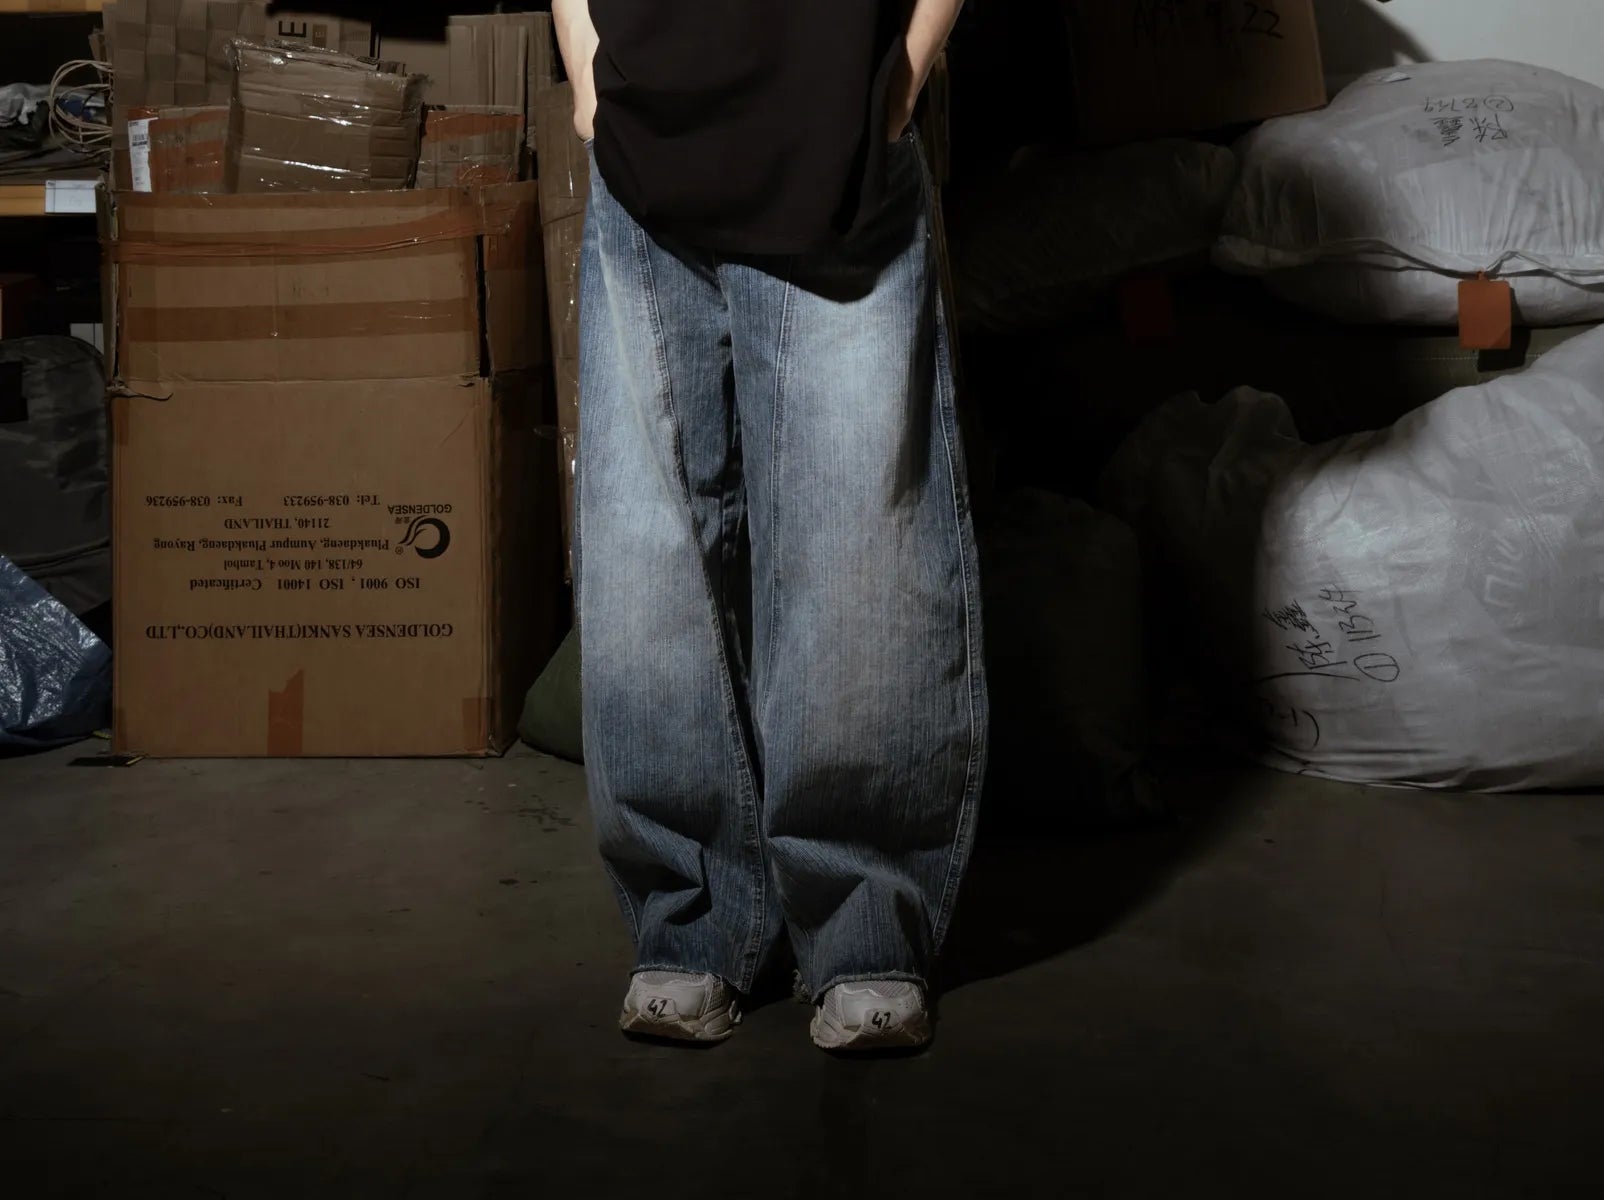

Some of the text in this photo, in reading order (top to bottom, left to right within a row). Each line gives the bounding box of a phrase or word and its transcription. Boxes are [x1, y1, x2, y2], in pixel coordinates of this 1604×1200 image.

[145, 494, 380, 508] Tel: 038-959233 Fax: 038-959236
[387, 503, 453, 515] GOLDENSEA
[223, 518, 291, 530] THAILAND
[152, 537, 196, 552] Rayong
[223, 560, 264, 572] Tambol
[278, 559, 302, 571] Moo
[304, 559, 322, 571] 140
[189, 578, 263, 592] Certificated
[277, 578, 311, 591] 14001
[318, 578, 344, 591] ISO
[395, 577, 421, 590] ISO
[354, 623, 454, 638] GOLDENSEA
[647, 998, 667, 1018] 42
